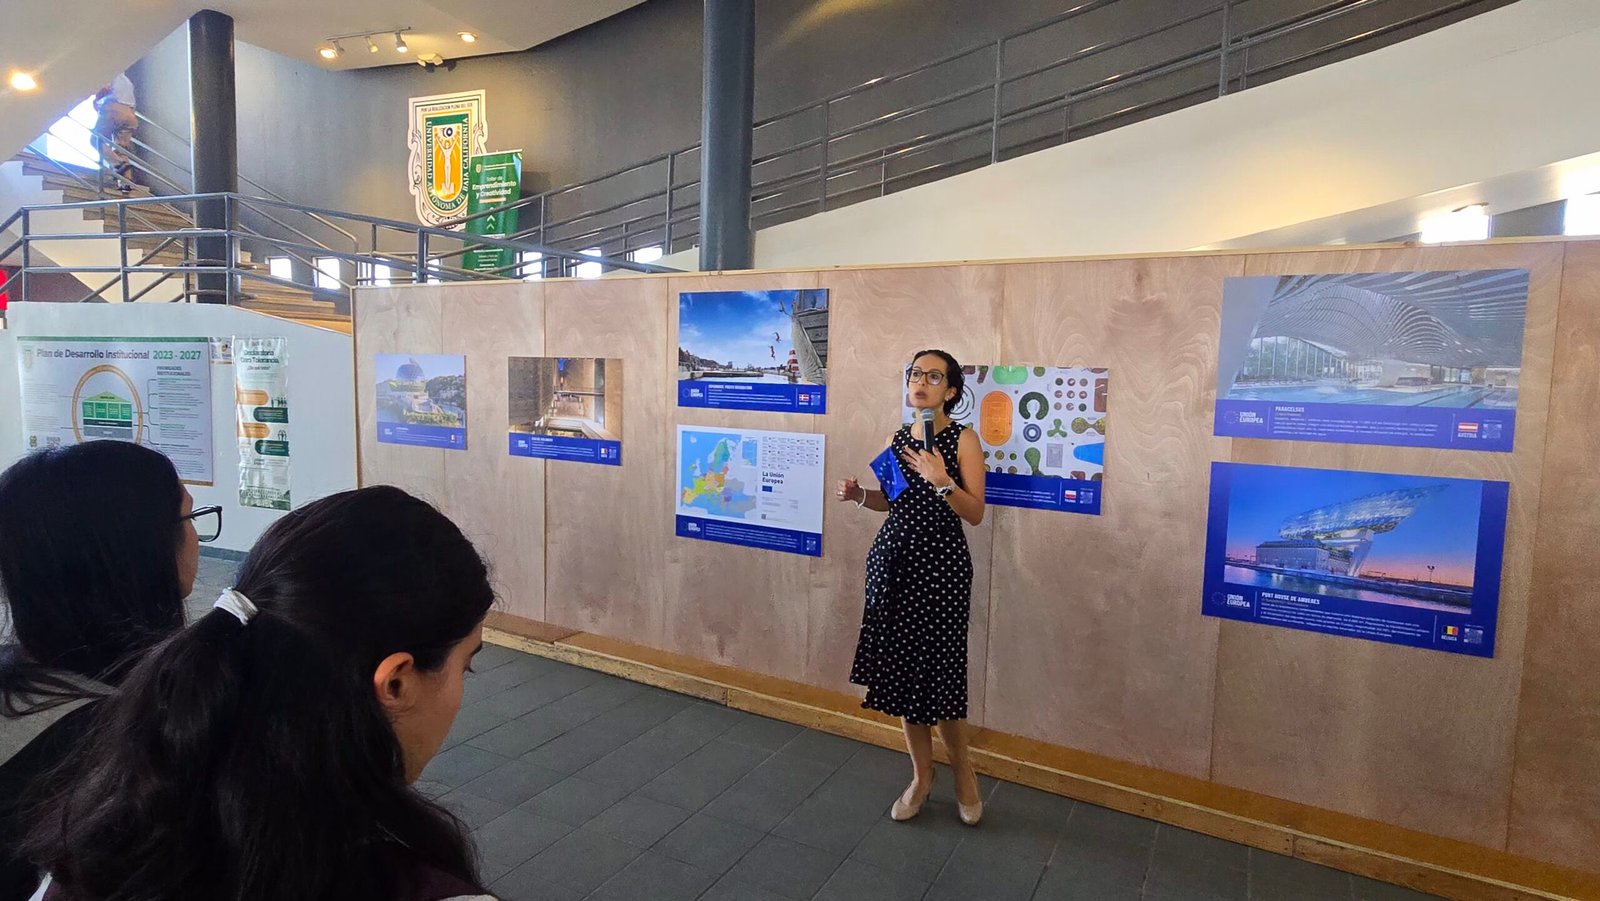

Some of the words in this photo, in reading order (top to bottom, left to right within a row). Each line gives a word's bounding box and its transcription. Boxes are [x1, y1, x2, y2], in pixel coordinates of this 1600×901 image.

[456, 194, 466, 205] DE
[462, 172, 470, 192] BAJA
[472, 180, 517, 191] Emprendimiento
[476, 192, 480, 200] y
[480, 188, 512, 197] Creatividad
[36, 349, 52, 358] Plan
[54, 350, 64, 358] de
[65, 349, 104, 359] Desarrollo
[105, 350, 150, 360] Institucional
[153, 351, 174, 360] 2023
[179, 351, 201, 360] 2027
[762, 477, 784, 485] Europea
[1227, 593, 1244, 601] UNIÓN
[1226, 600, 1251, 608] EUROPEA
